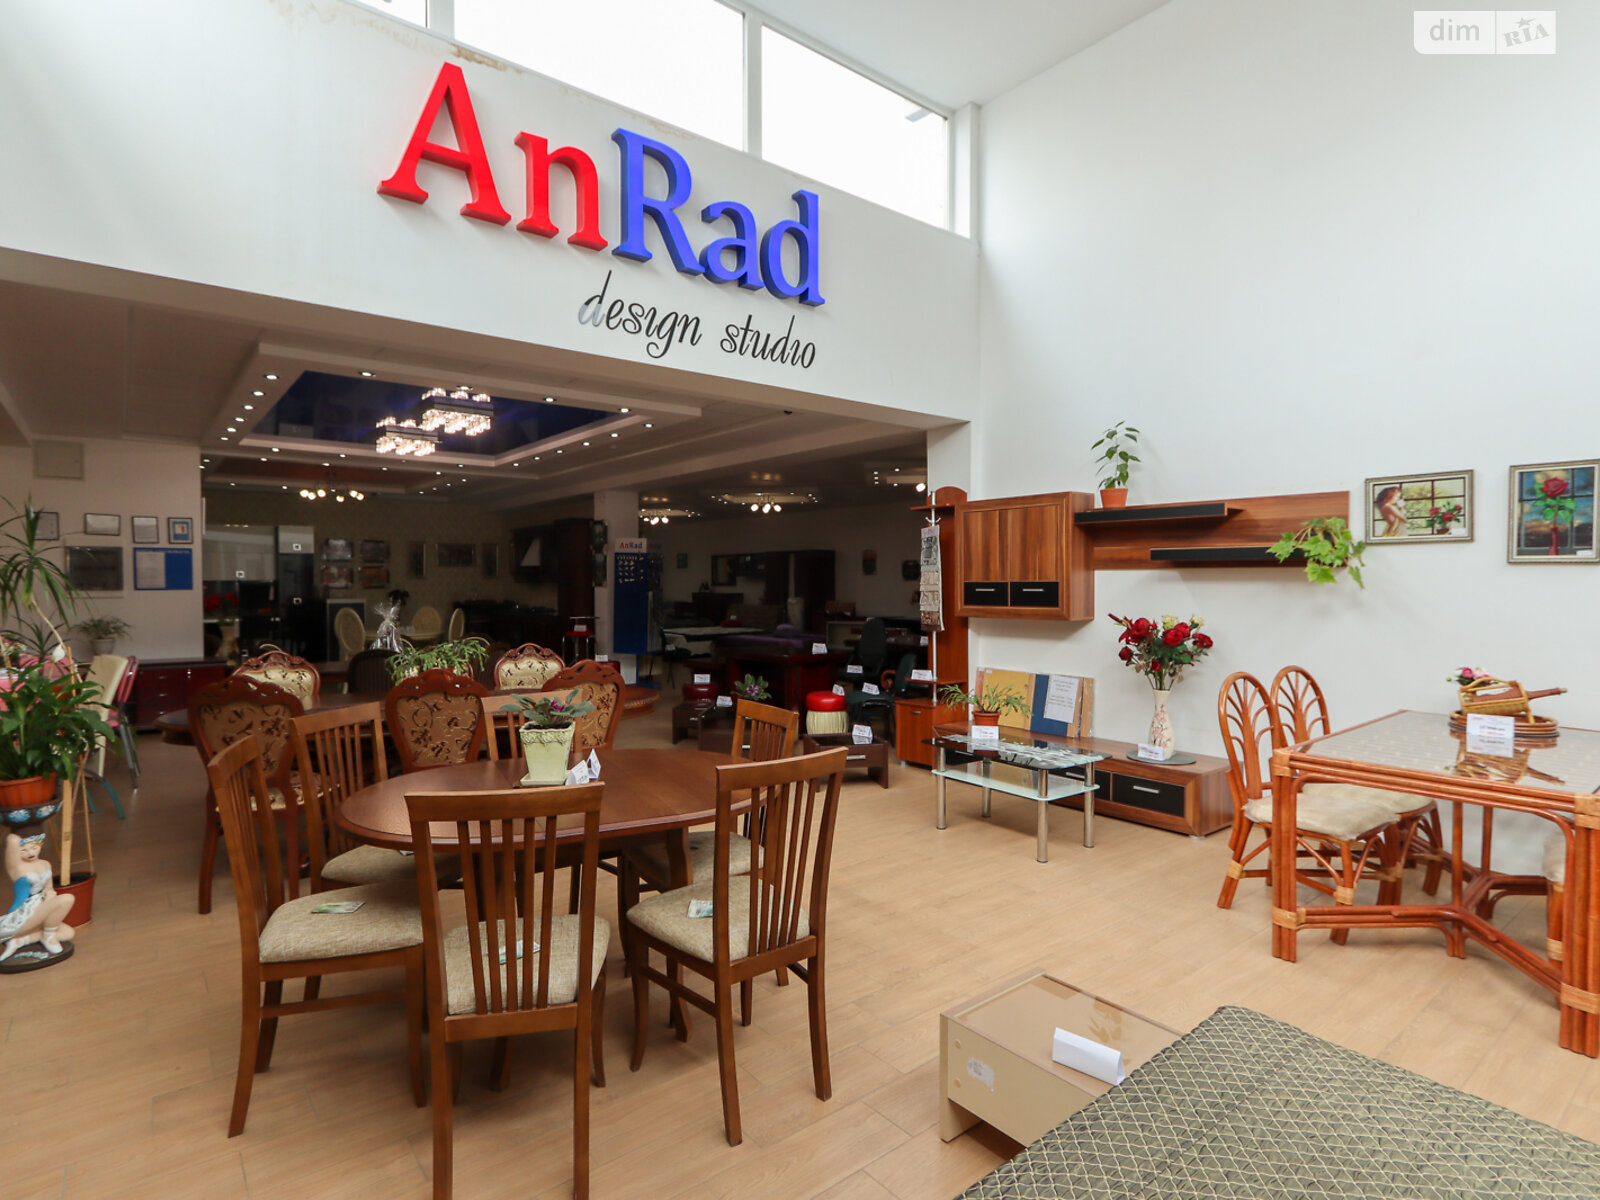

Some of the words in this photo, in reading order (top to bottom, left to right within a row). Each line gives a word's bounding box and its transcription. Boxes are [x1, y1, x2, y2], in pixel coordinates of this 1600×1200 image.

[376, 62, 825, 306] AnRad
[578, 270, 702, 359] design
[720, 314, 816, 369] studio
